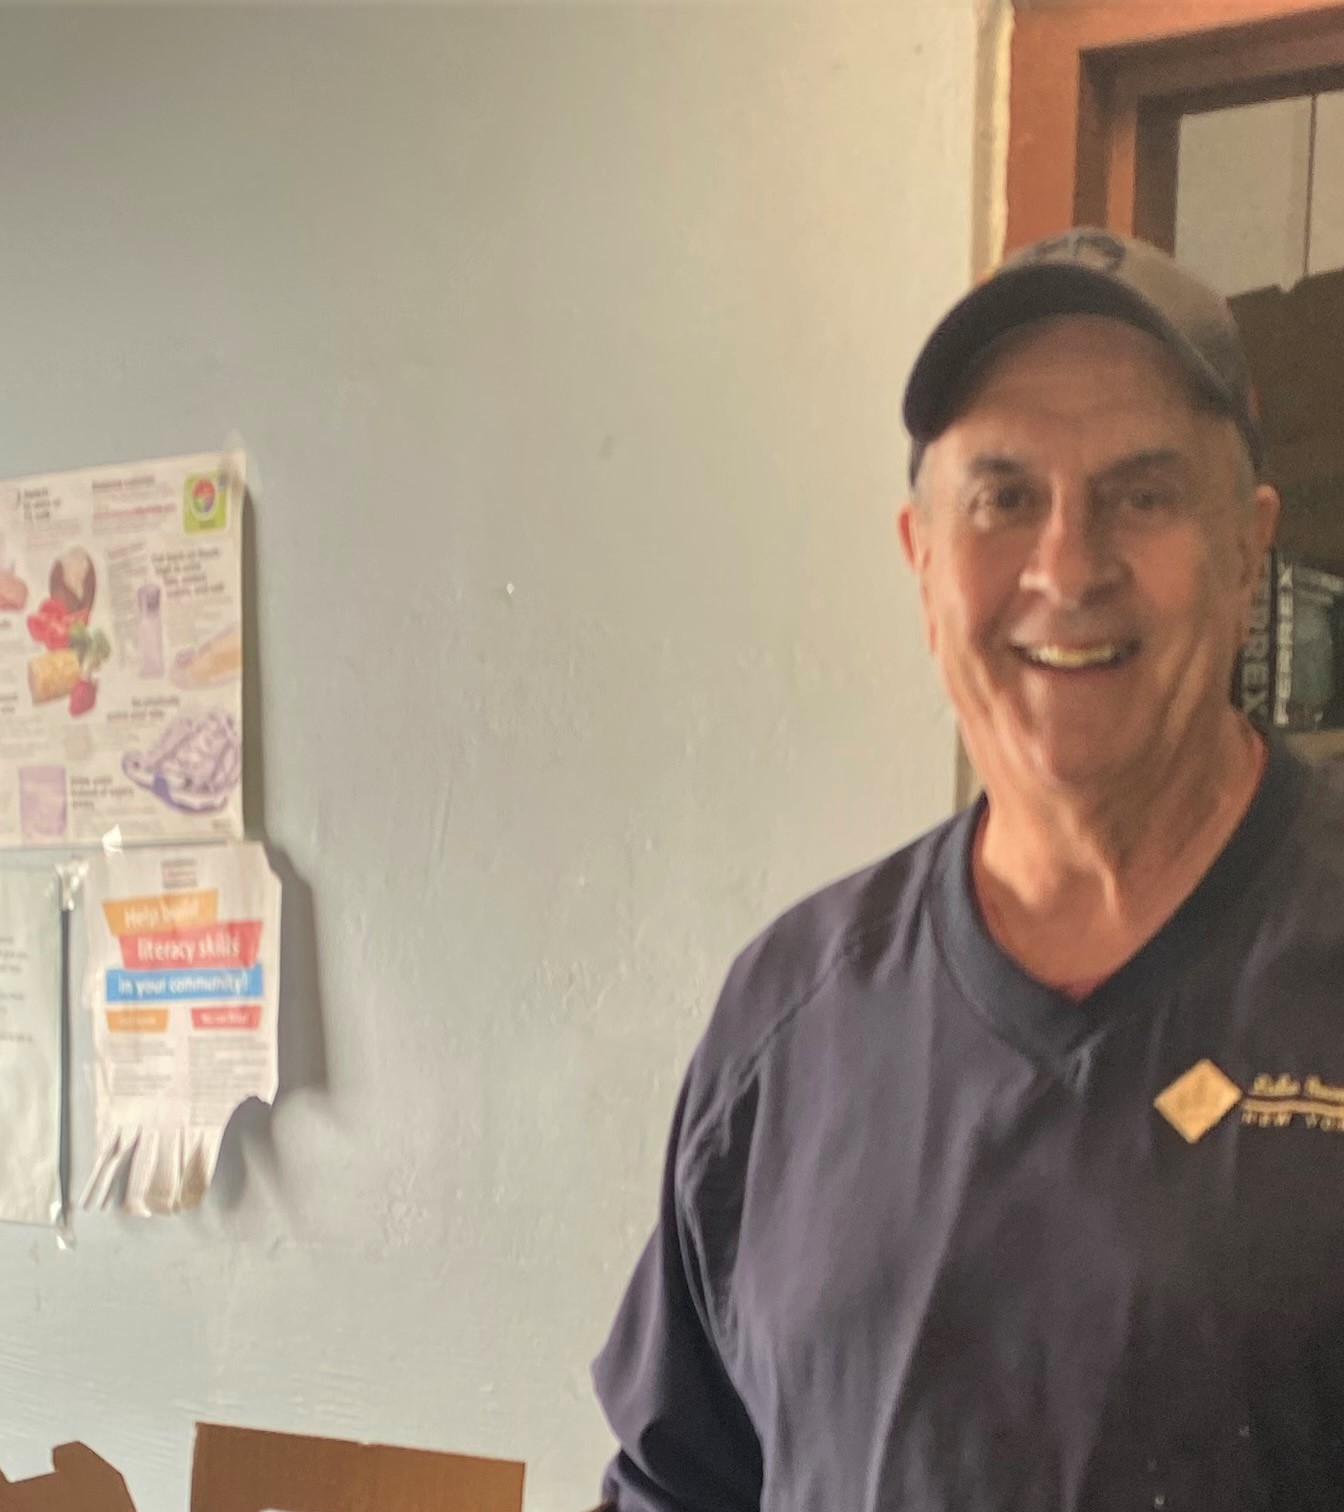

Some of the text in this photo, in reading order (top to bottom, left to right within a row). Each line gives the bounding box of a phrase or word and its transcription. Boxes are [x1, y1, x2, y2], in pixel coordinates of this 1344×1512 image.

[123, 904, 159, 931] Help
[136, 930, 242, 965] literacy skills
